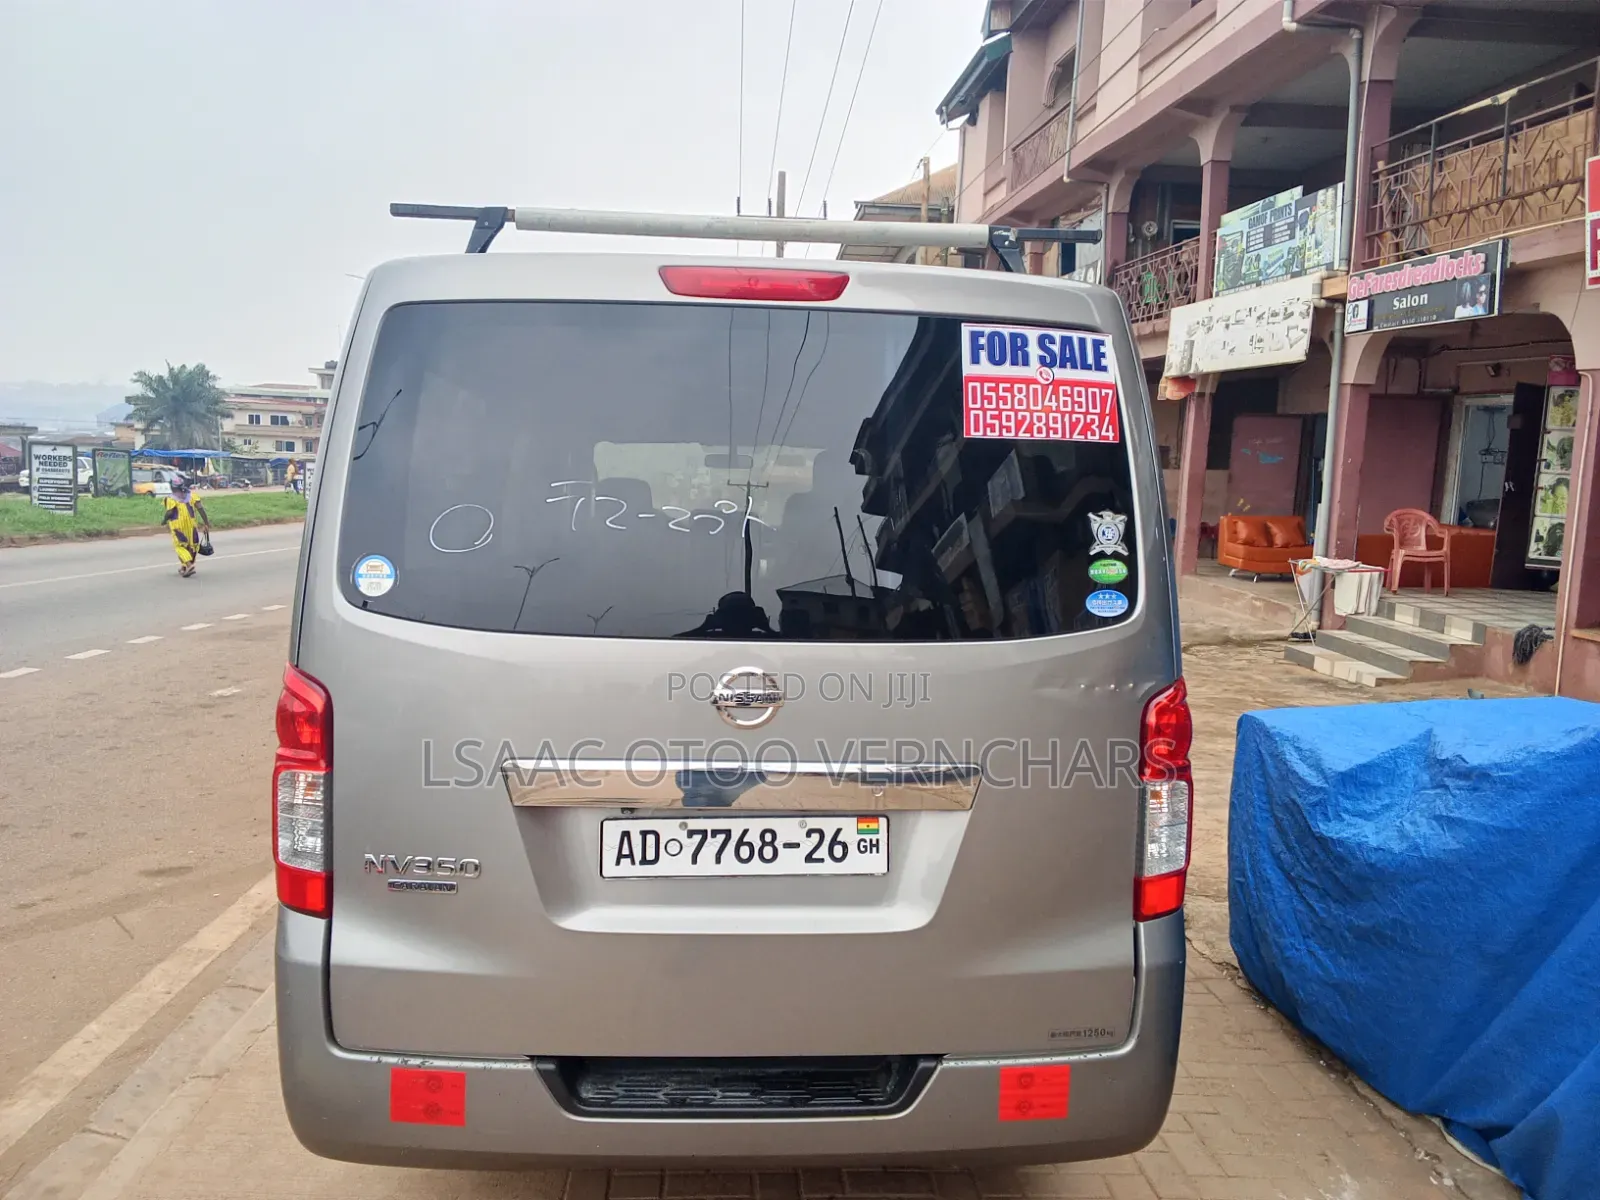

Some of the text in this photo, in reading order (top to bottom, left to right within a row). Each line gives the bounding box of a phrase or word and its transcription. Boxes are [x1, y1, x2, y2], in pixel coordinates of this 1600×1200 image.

[1393, 293, 1428, 310] Salon
[969, 330, 1108, 372] FOR SALE
[968, 382, 1114, 415] 0558046907
[970, 410, 1115, 441] 0592891234
[33, 453, 73, 462] WORKERS
[716, 692, 782, 705] NISSAN
[615, 827, 849, 866] AD 7768-26
[857, 838, 880, 854] GH
[364, 854, 481, 878] NV350
